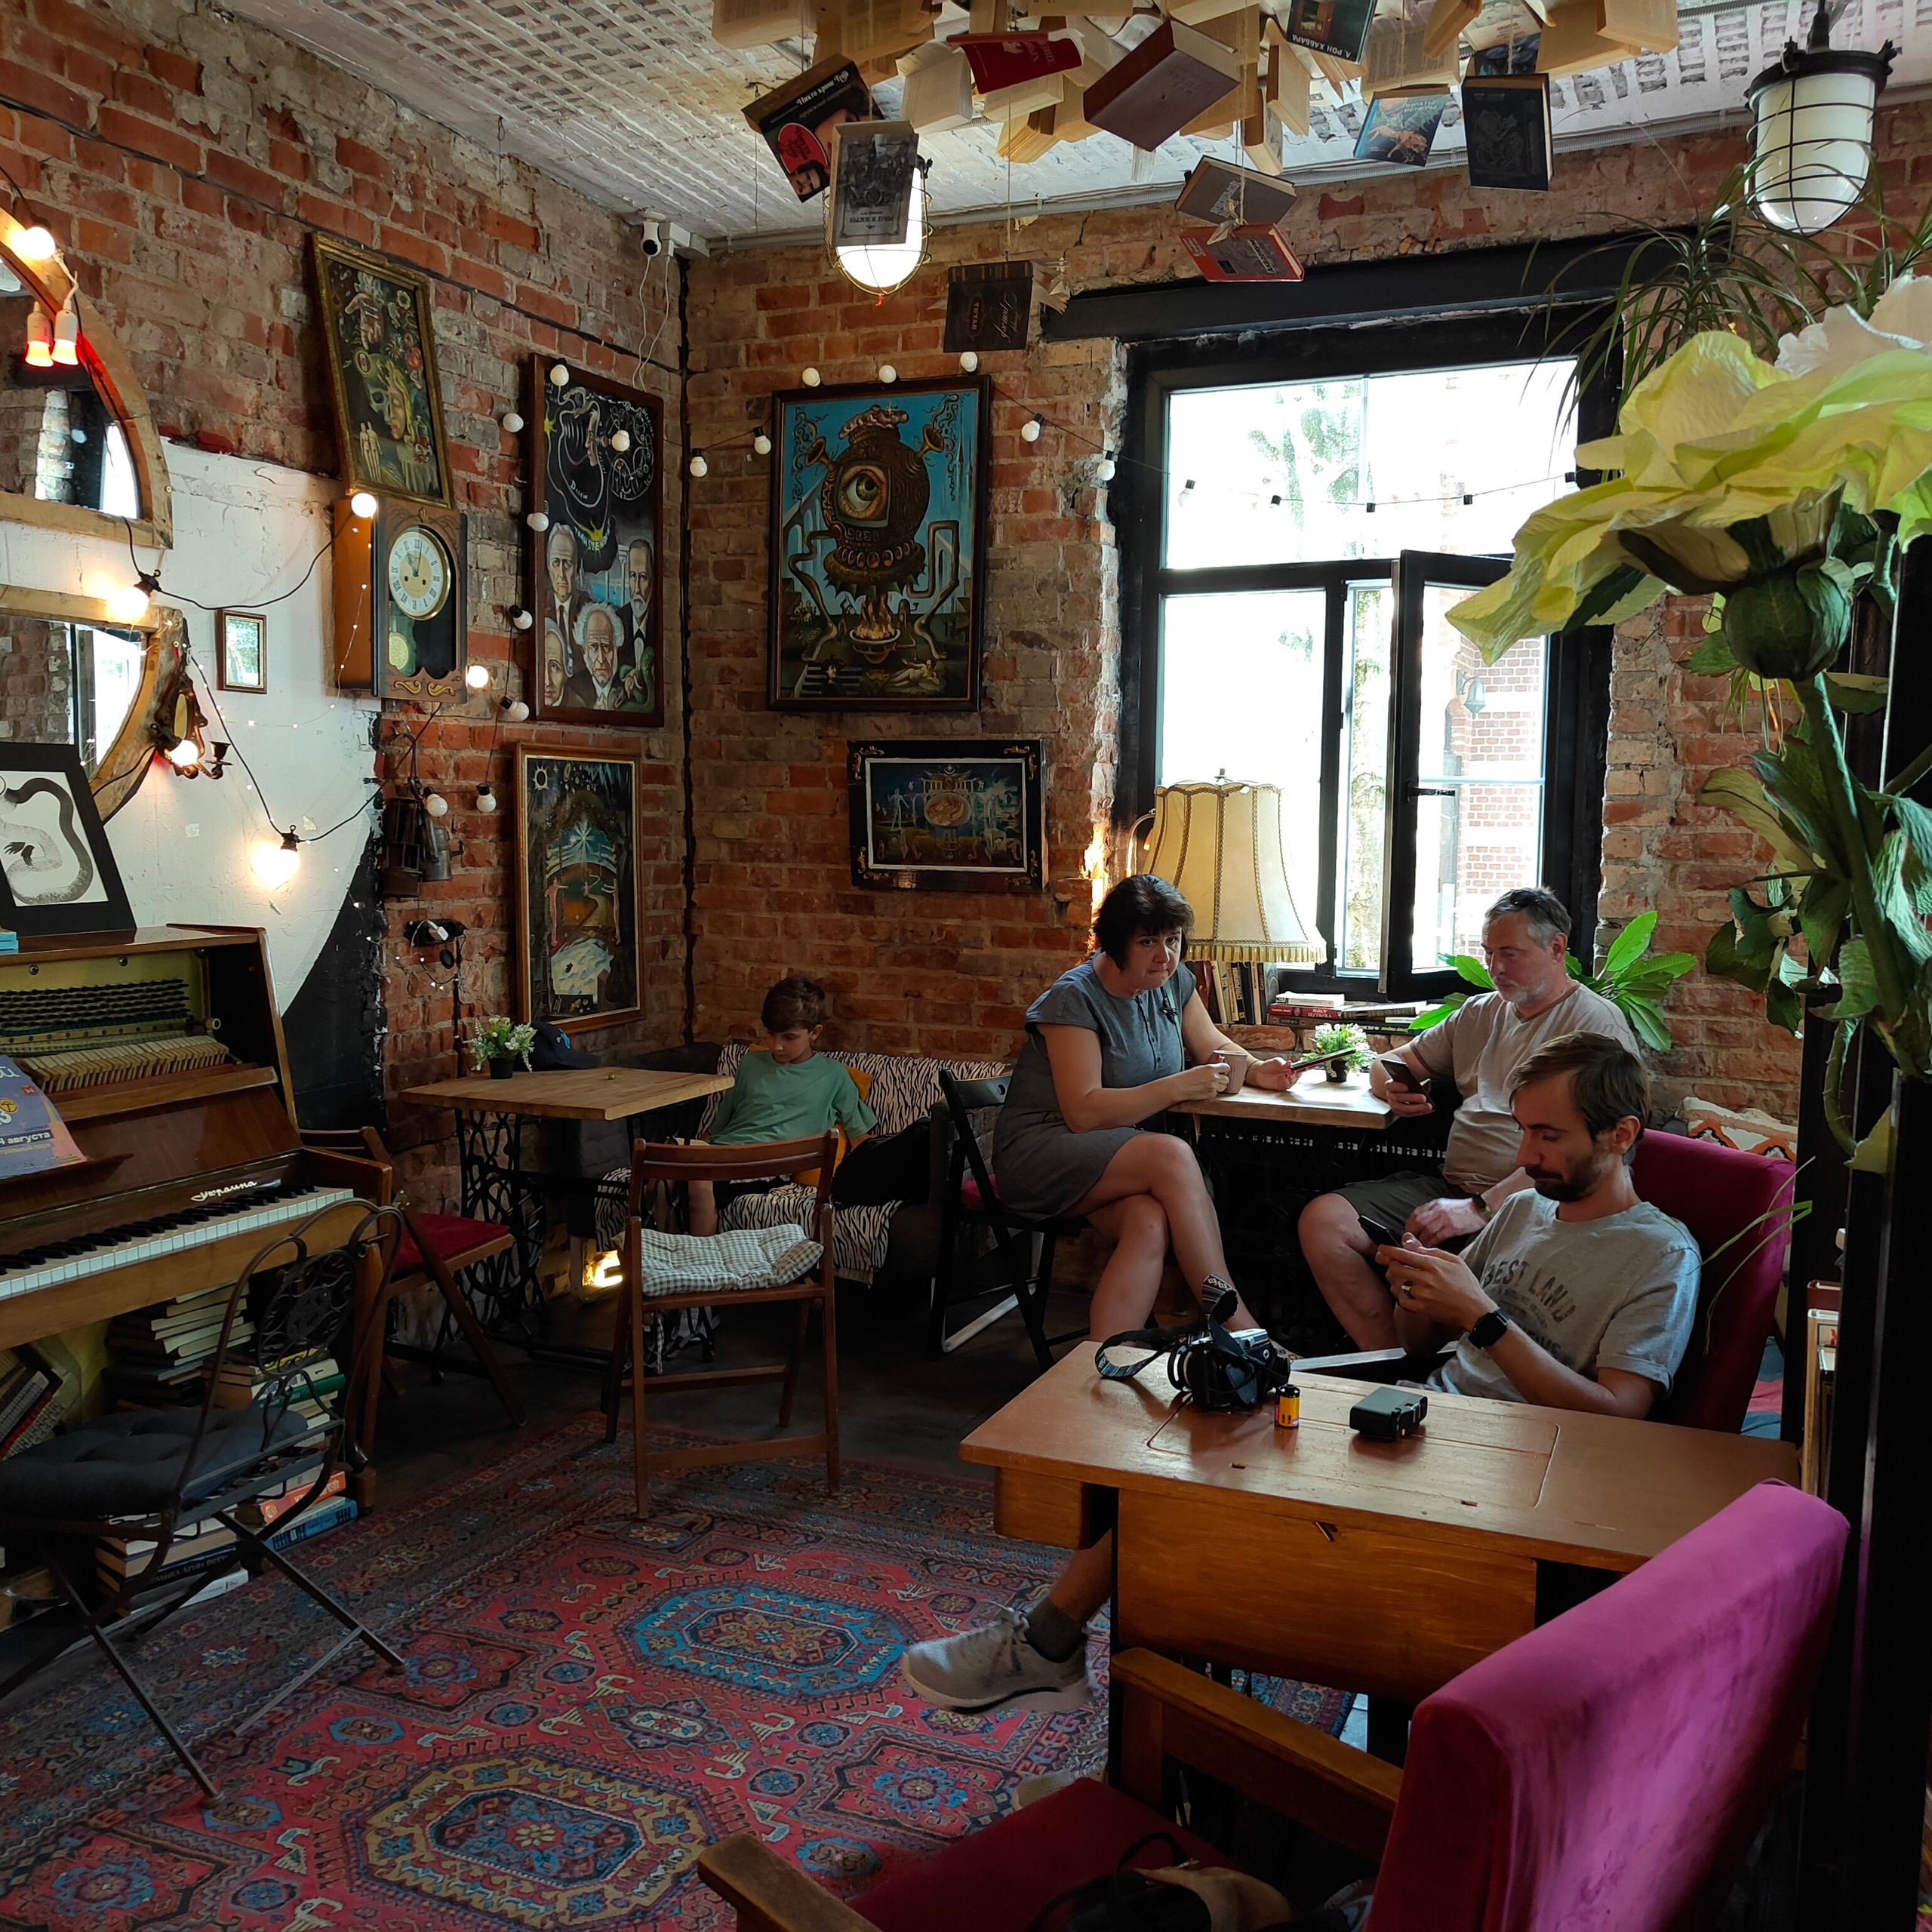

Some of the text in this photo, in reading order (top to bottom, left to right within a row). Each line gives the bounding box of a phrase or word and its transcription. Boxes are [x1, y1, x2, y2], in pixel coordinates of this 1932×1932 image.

[1291, 33, 1324, 51] ХАББАРД
[1326, 47, 1343, 56] РОН
[817, 80, 835, 94] кроме
[971, 301, 980, 331] ТИТАН
[7, 1131, 51, 1145] августа
[1483, 1260, 1530, 1288] BEST
[1527, 1269, 1577, 1324] LAND
